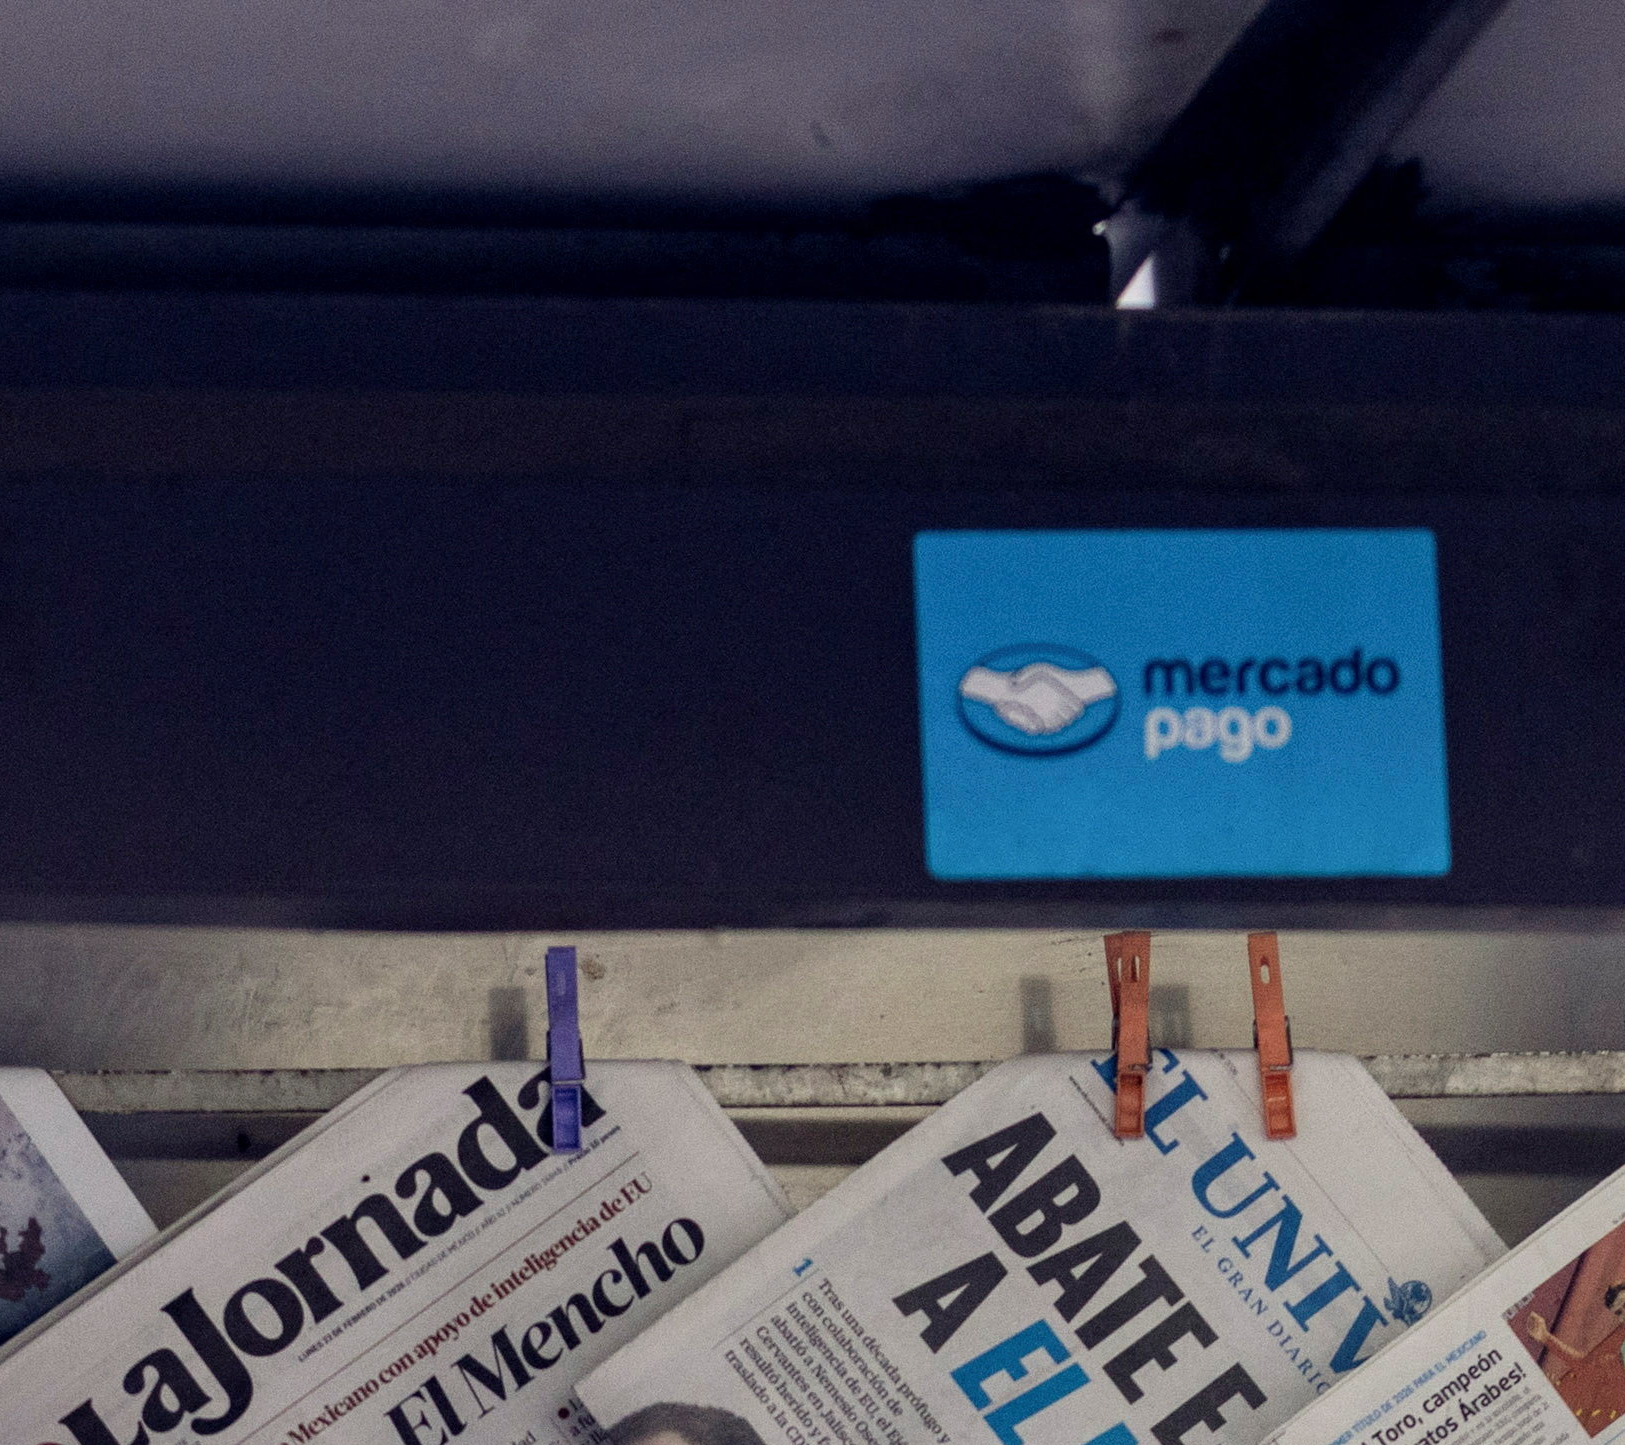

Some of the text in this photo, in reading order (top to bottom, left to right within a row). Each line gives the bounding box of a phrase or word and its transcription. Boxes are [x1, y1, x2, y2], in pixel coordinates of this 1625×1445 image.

[1144, 647, 1398, 695] mercado
[1144, 705, 1291, 762] pago
[894, 1251, 1005, 1354] A
[941, 1112, 1218, 1405] ABATE
[1192, 1226, 1214, 1252] EL
[1218, 1258, 1268, 1315] GRAN
[288, 1380, 379, 1443] Mexicano
[379, 1354, 415, 1384] con
[415, 1313, 470, 1359] apoyo
[468, 1292, 494, 1317] de
[491, 1217, 601, 1299] inteligencia
[598, 1197, 624, 1222] de
[619, 1177, 649, 1204] EU
[455, 1219, 704, 1416] Mencho
[1423, 1350, 1502, 1414] campeón
[1459, 1363, 1522, 1421] Árabes!
